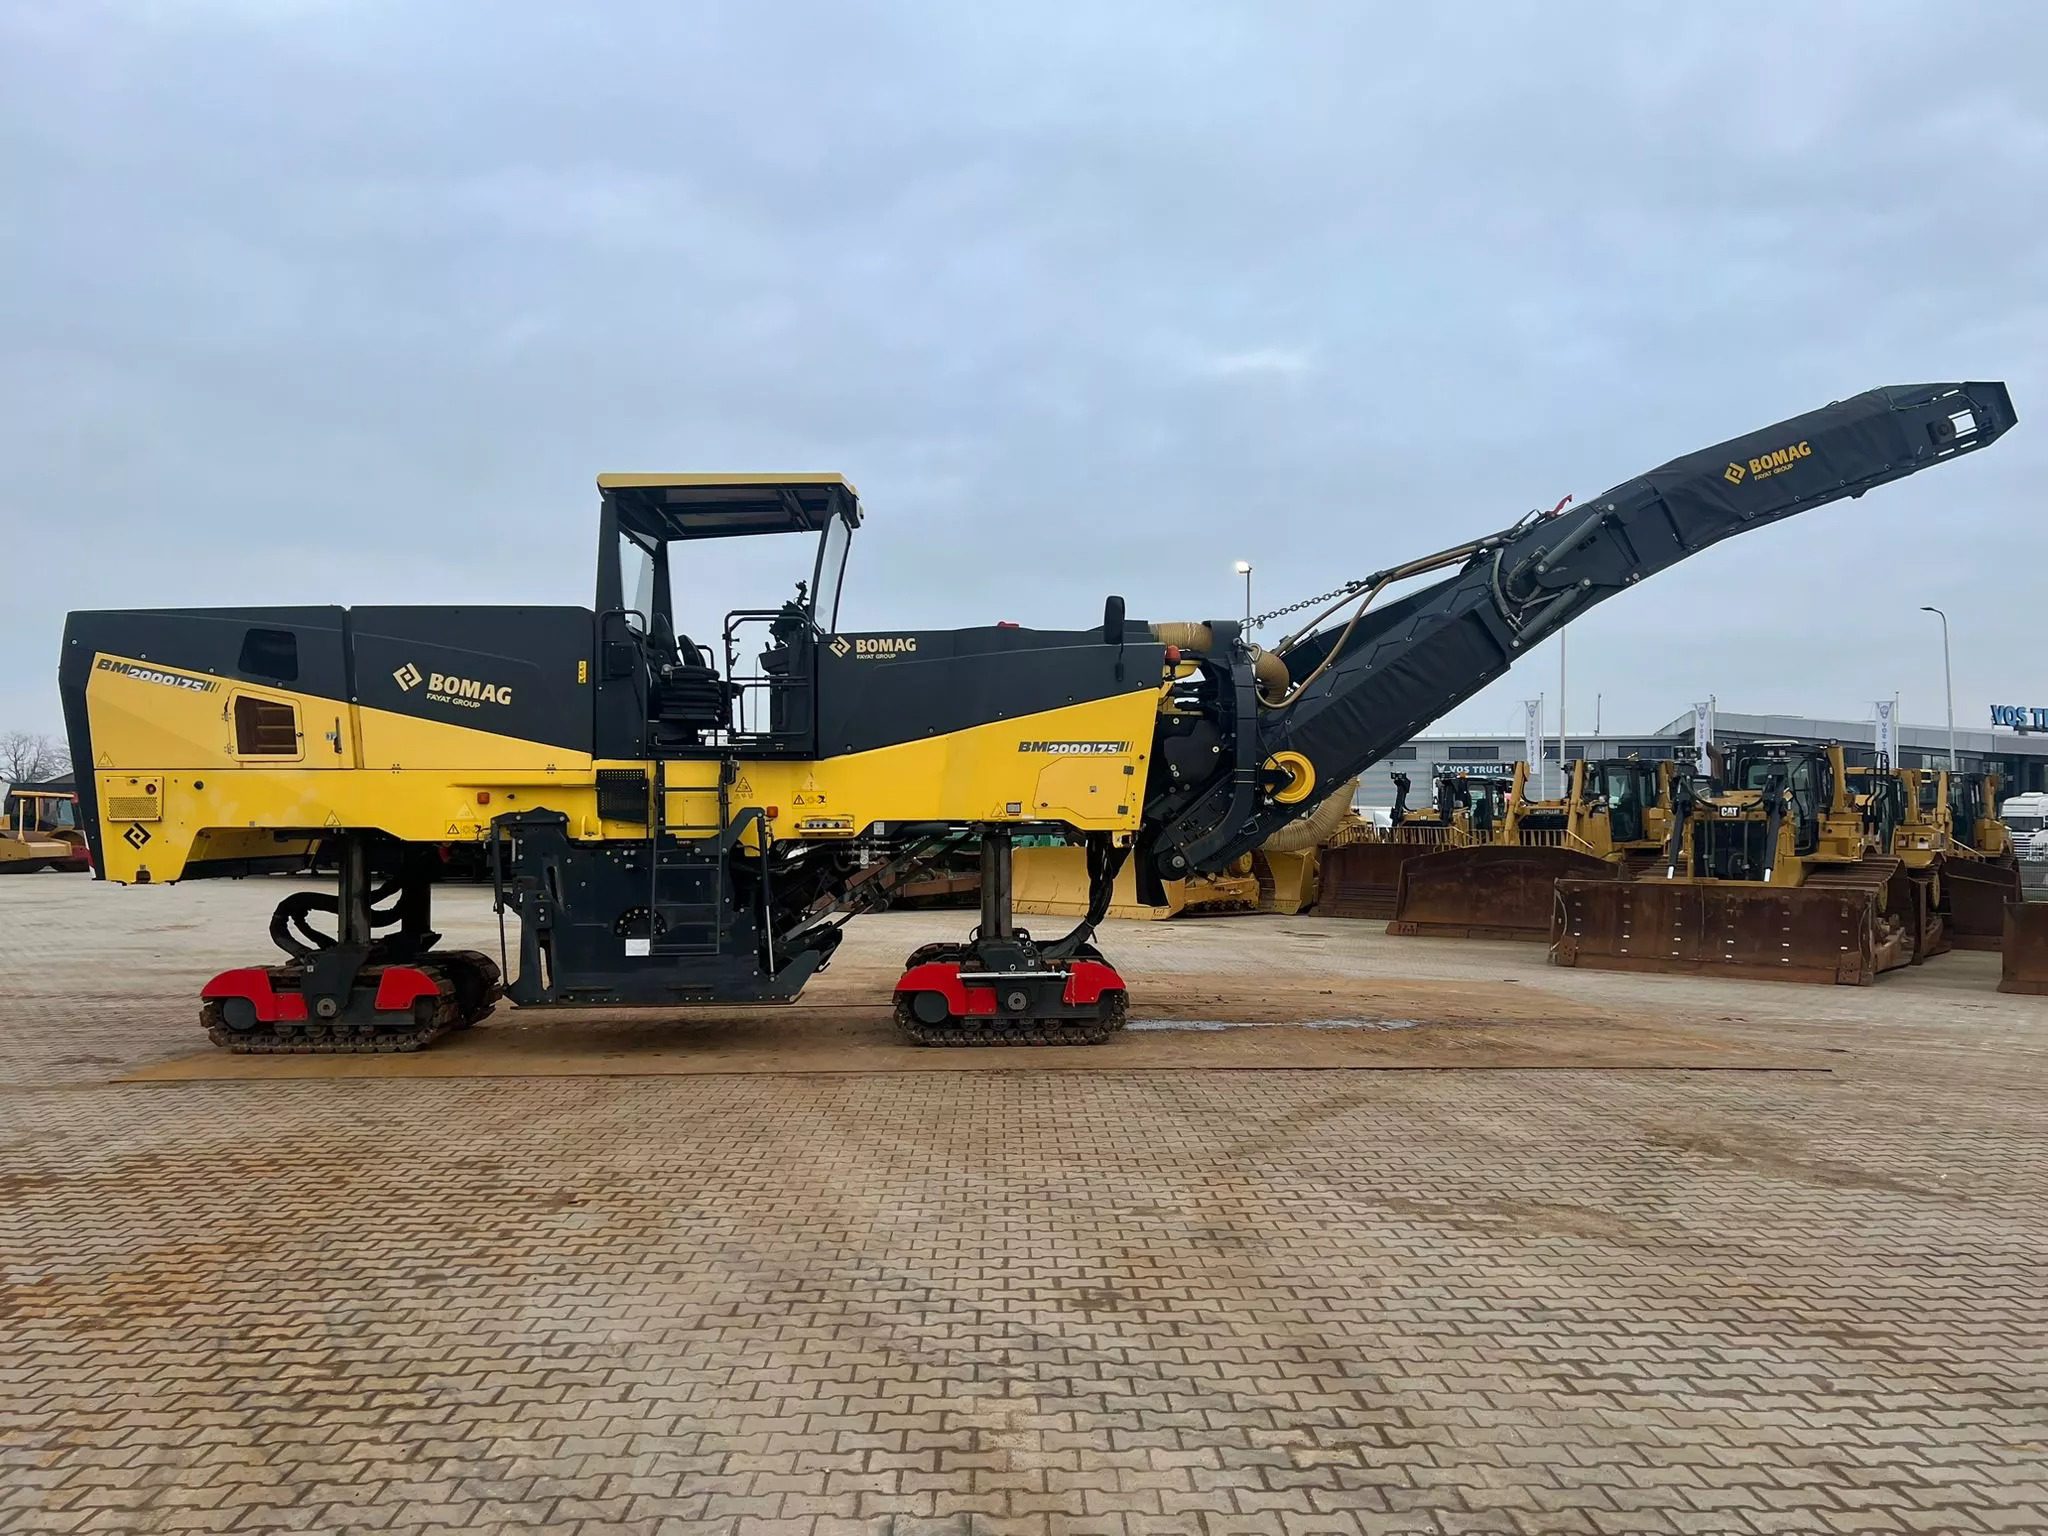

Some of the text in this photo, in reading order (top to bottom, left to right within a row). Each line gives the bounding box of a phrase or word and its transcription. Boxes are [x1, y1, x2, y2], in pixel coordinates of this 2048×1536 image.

[1749, 441, 1812, 474] BOMAG
[1754, 463, 1794, 481] FAYAT GROUP
[855, 638, 916, 653] BOMAG
[428, 673, 512, 705] BOMAG
[426, 693, 481, 708] FAYAT GROUP
[1990, 705, 2027, 726] VOS
[1449, 765, 1470, 774] VOS
[1721, 807, 1738, 817] CAT
